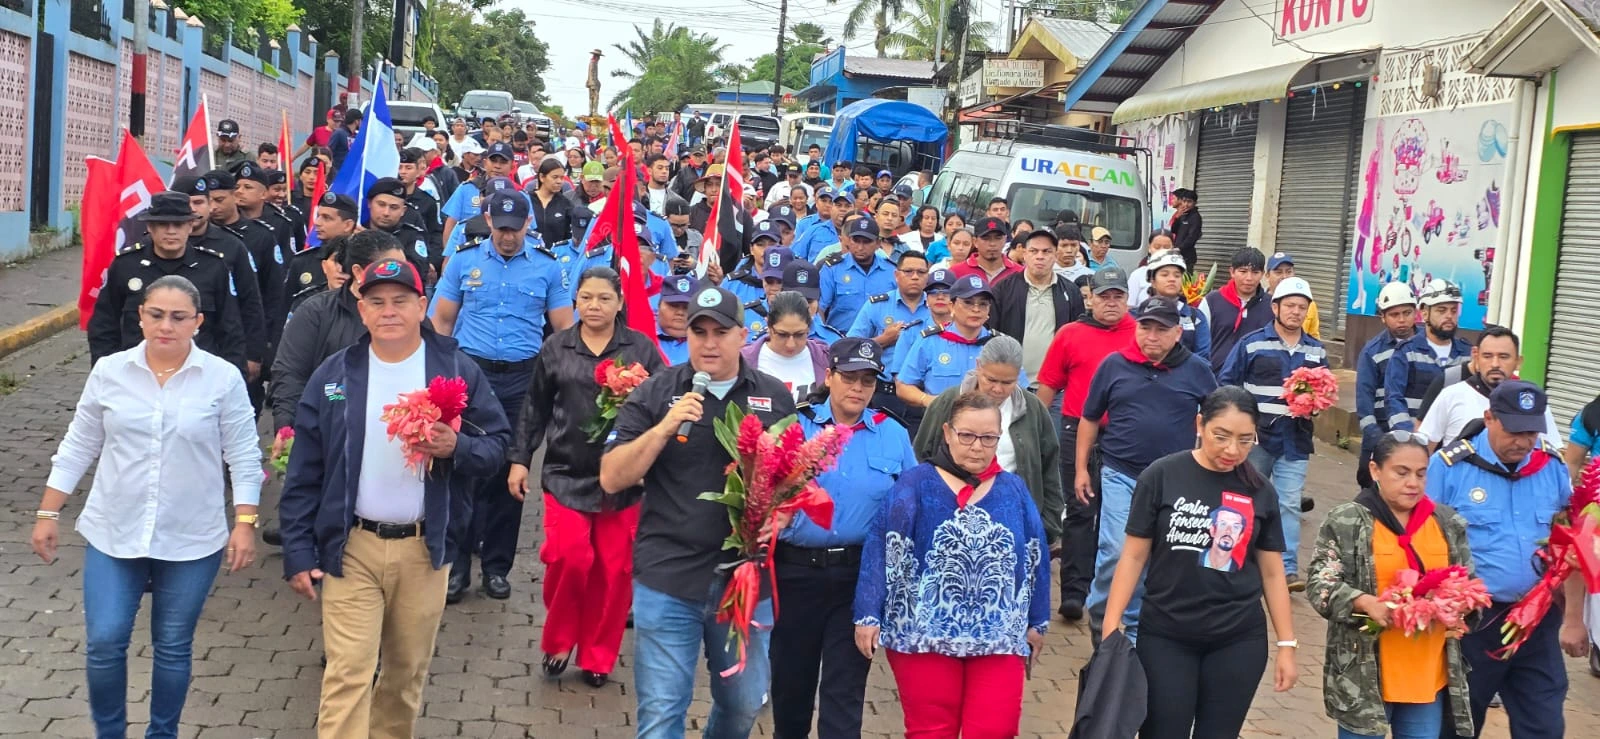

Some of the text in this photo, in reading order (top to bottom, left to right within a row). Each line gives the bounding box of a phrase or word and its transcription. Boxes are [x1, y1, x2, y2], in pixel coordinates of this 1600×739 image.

[1021, 157, 1136, 187] URACCAN
[1174, 497, 1210, 516] Carlos
[1170, 512, 1213, 529] Fonseca
[1166, 527, 1211, 546] Amador
